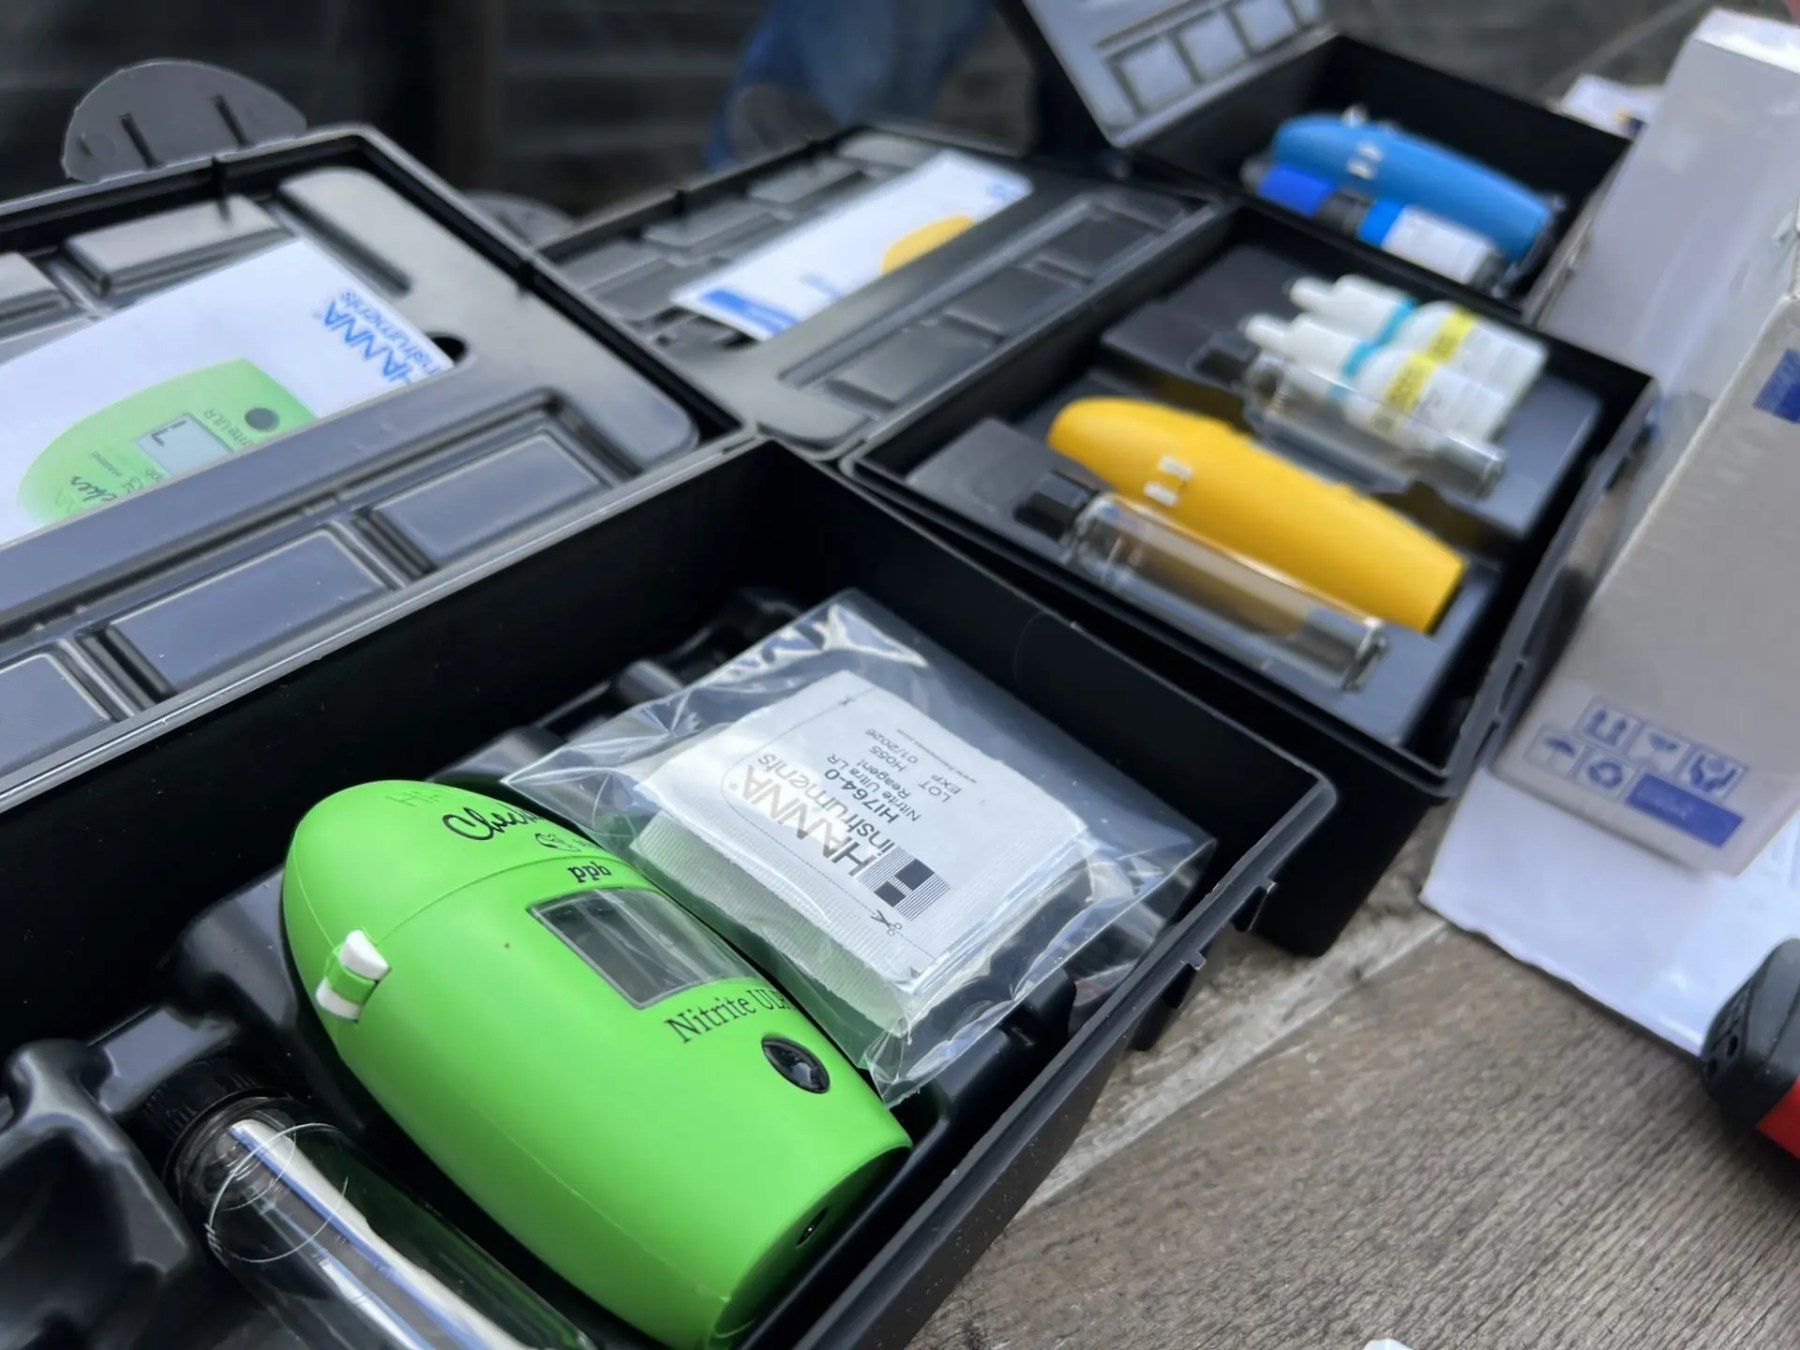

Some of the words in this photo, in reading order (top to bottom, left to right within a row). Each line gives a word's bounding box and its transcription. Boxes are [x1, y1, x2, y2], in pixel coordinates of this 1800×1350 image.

[340, 291, 440, 374] nstruments
[826, 753, 850, 769] LR
[857, 758, 911, 800] Reagent
[824, 768, 900, 824] HI764-0
[849, 767, 880, 793] Ultra
[918, 780, 951, 803] LOT
[931, 774, 962, 796] EXP
[742, 764, 877, 877] HANNA
[758, 753, 895, 857] instruments
[882, 791, 921, 822] Nitrite
[567, 861, 612, 884] ppb
[663, 997, 757, 1044] Nitrite
